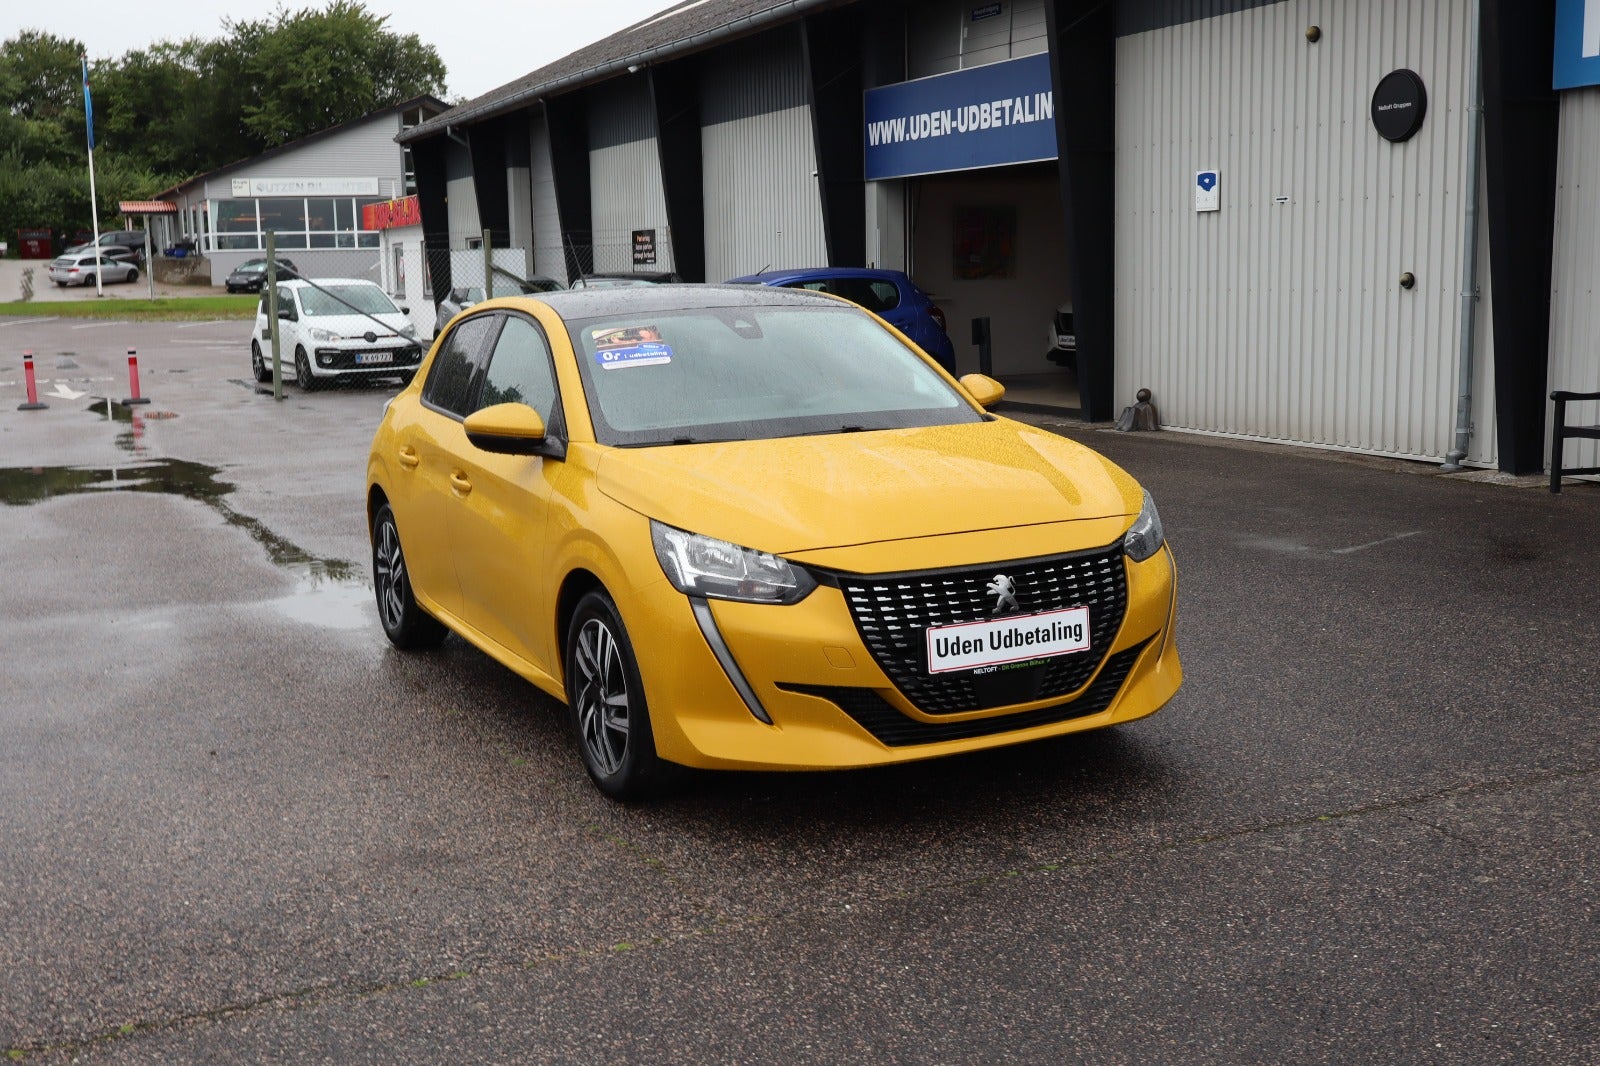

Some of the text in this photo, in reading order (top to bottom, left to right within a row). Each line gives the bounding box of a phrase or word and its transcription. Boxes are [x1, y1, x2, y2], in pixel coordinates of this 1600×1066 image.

[867, 91, 1054, 146] WWW.UDEN-UDBETALIN
[936, 621, 1083, 658] Uden Udbetaling
